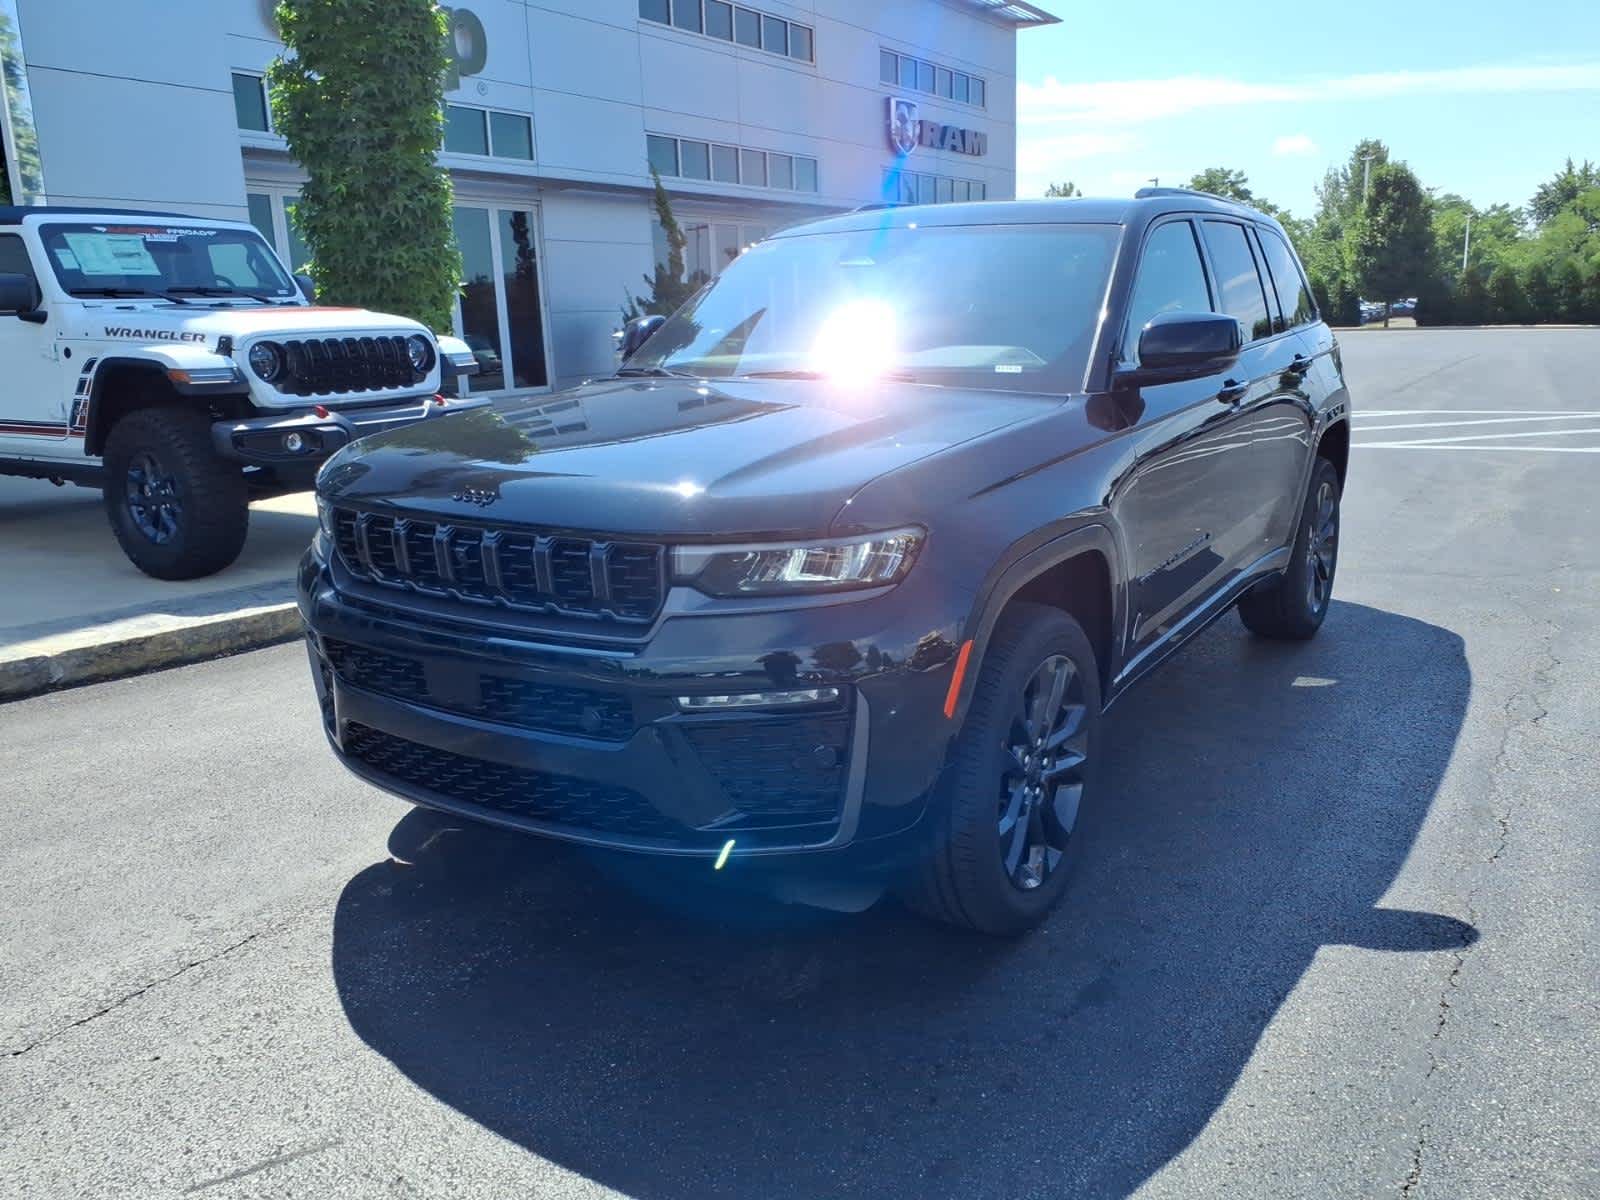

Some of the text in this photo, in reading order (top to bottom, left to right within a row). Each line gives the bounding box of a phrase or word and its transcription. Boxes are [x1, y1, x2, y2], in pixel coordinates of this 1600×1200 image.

[919, 120, 987, 156] RAM
[104, 326, 206, 343] WRANGLER
[451, 488, 496, 508] Jeep
